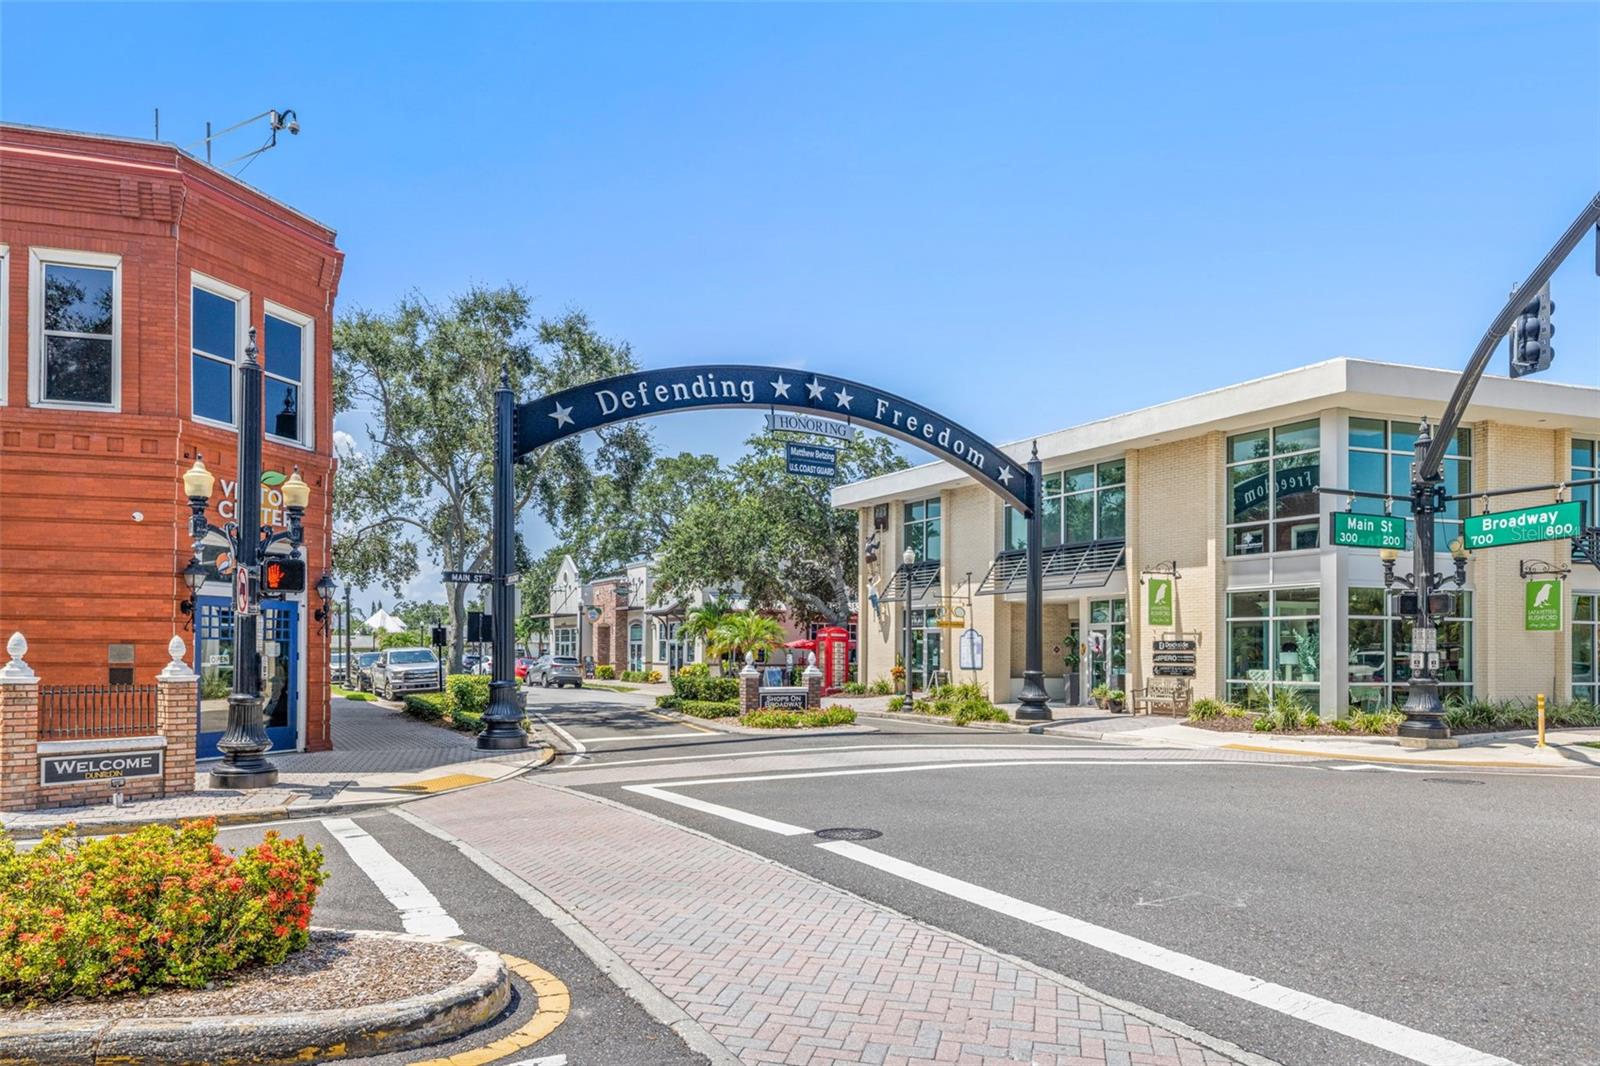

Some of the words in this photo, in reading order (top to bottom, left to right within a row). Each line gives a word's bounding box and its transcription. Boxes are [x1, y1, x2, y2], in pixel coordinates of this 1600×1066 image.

[595, 373, 754, 416] Defending
[780, 416, 847, 436] HONORING
[875, 398, 985, 469] Freedom
[790, 446, 814, 458] Matthew
[789, 463, 799, 472] U.S.
[800, 464, 817, 474] COAST
[817, 466, 835, 476] GUARD
[1347, 517, 1374, 532] Main
[1381, 520, 1393, 532] St
[1482, 510, 1558, 531] Broadway
[1340, 532, 1358, 543] 300
[1383, 535, 1400, 546] 200
[1471, 534, 1494, 546] 700
[451, 573, 470, 582] MAIN
[474, 574, 483, 582] ST
[53, 757, 152, 774] WELCOME
